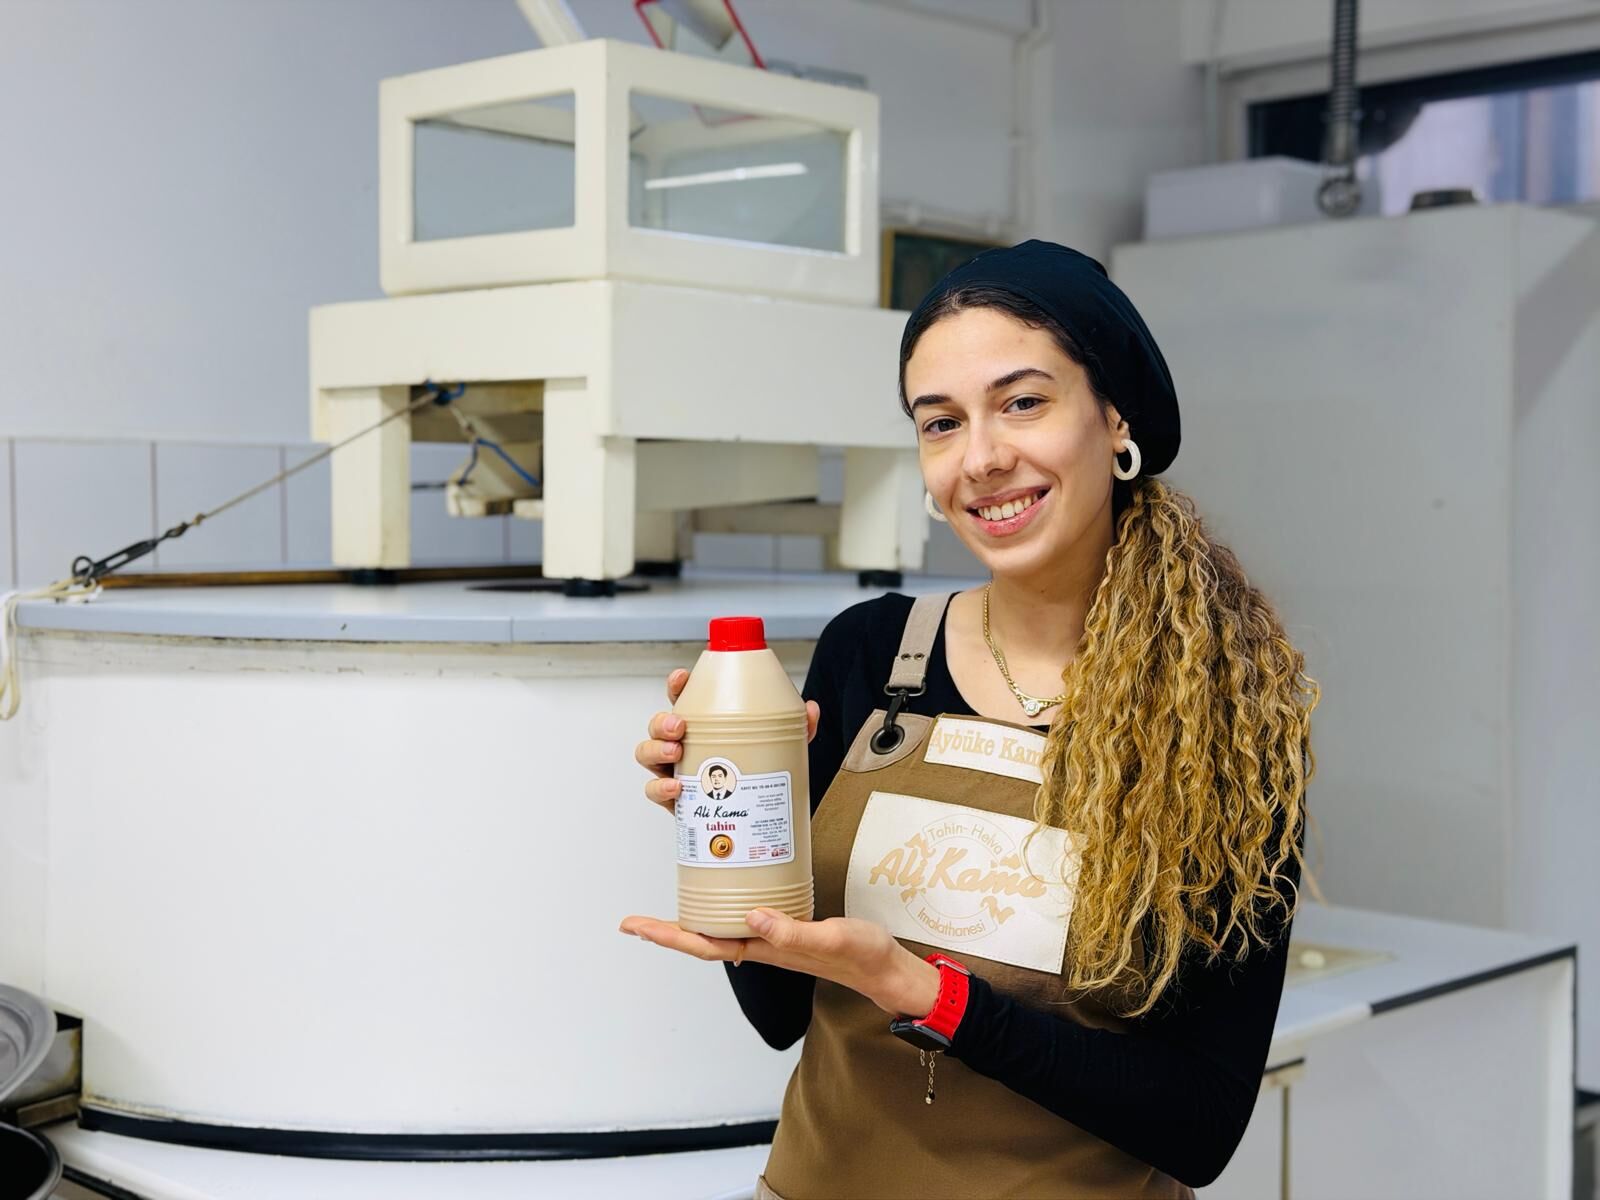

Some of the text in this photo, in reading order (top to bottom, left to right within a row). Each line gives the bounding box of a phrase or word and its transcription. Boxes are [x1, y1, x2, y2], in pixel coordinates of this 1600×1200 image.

[929, 727, 1042, 768] Aybüke Kam
[694, 805, 711, 818] Ali
[713, 805, 749, 818] Kama
[706, 821, 736, 832] tahin
[972, 823, 1003, 855] Helva
[868, 847, 1047, 898] Ali Kama
